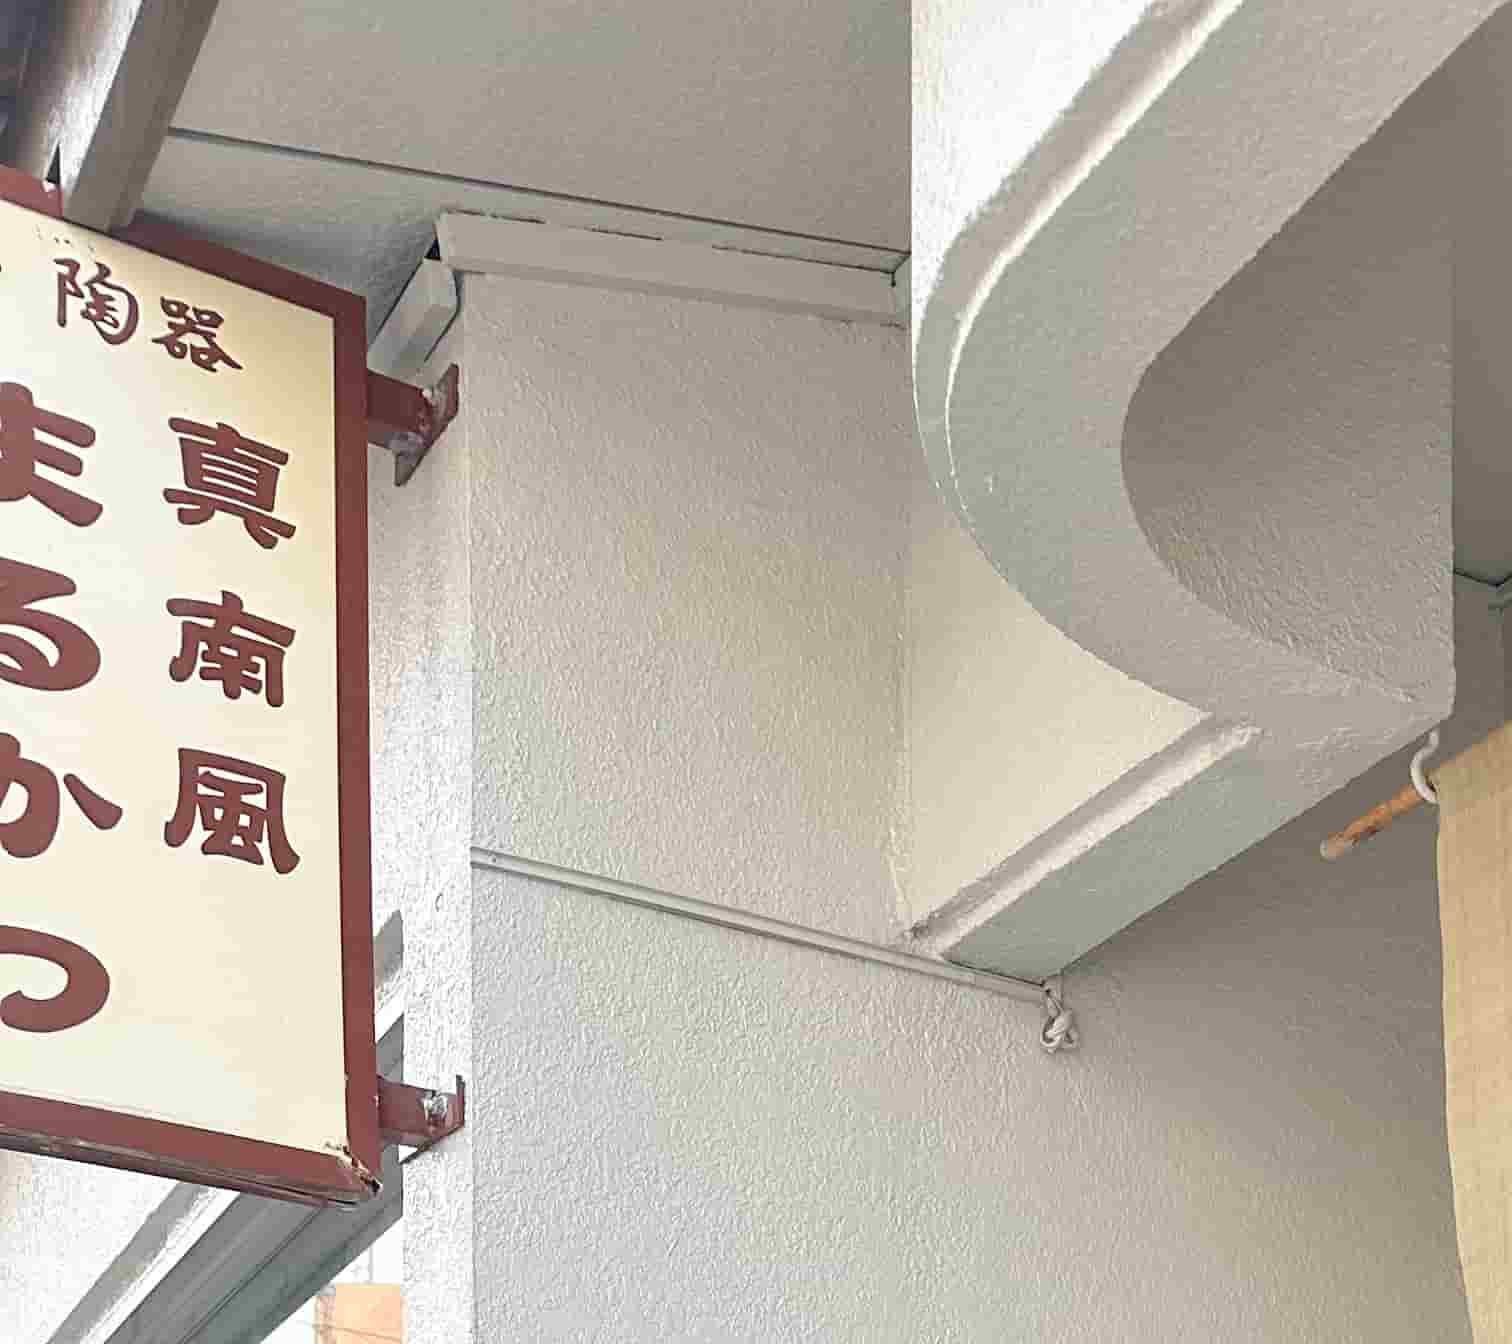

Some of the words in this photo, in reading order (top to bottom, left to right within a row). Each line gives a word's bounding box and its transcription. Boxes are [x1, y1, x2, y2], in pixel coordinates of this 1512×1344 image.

[52, 257, 244, 373] 陶器
[163, 416, 301, 875] 真南風
